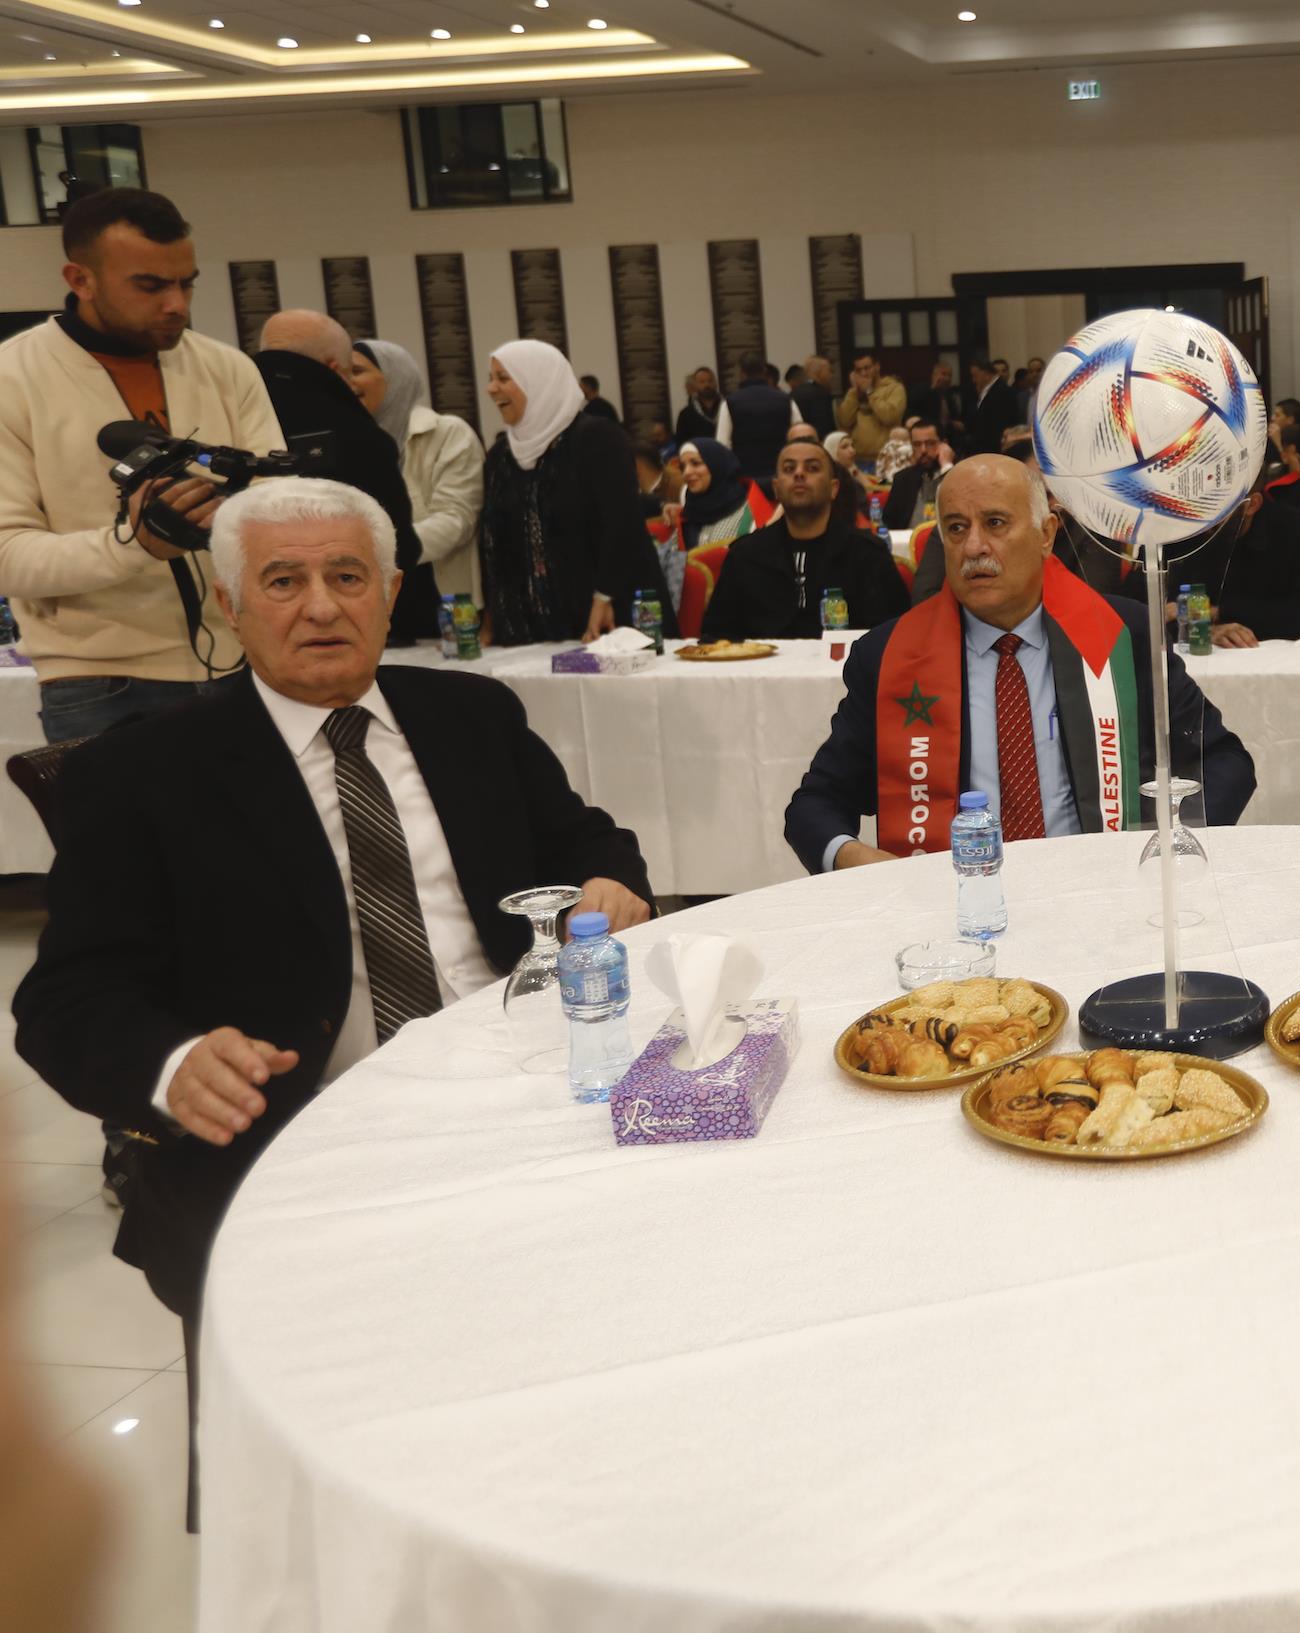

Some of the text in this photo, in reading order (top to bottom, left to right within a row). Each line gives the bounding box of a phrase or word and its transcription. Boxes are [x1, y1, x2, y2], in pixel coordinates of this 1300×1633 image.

[1069, 82, 1097, 98] EXIT
[1097, 716, 1119, 831] ALESTINE
[622, 1097, 696, 1137] Reema
